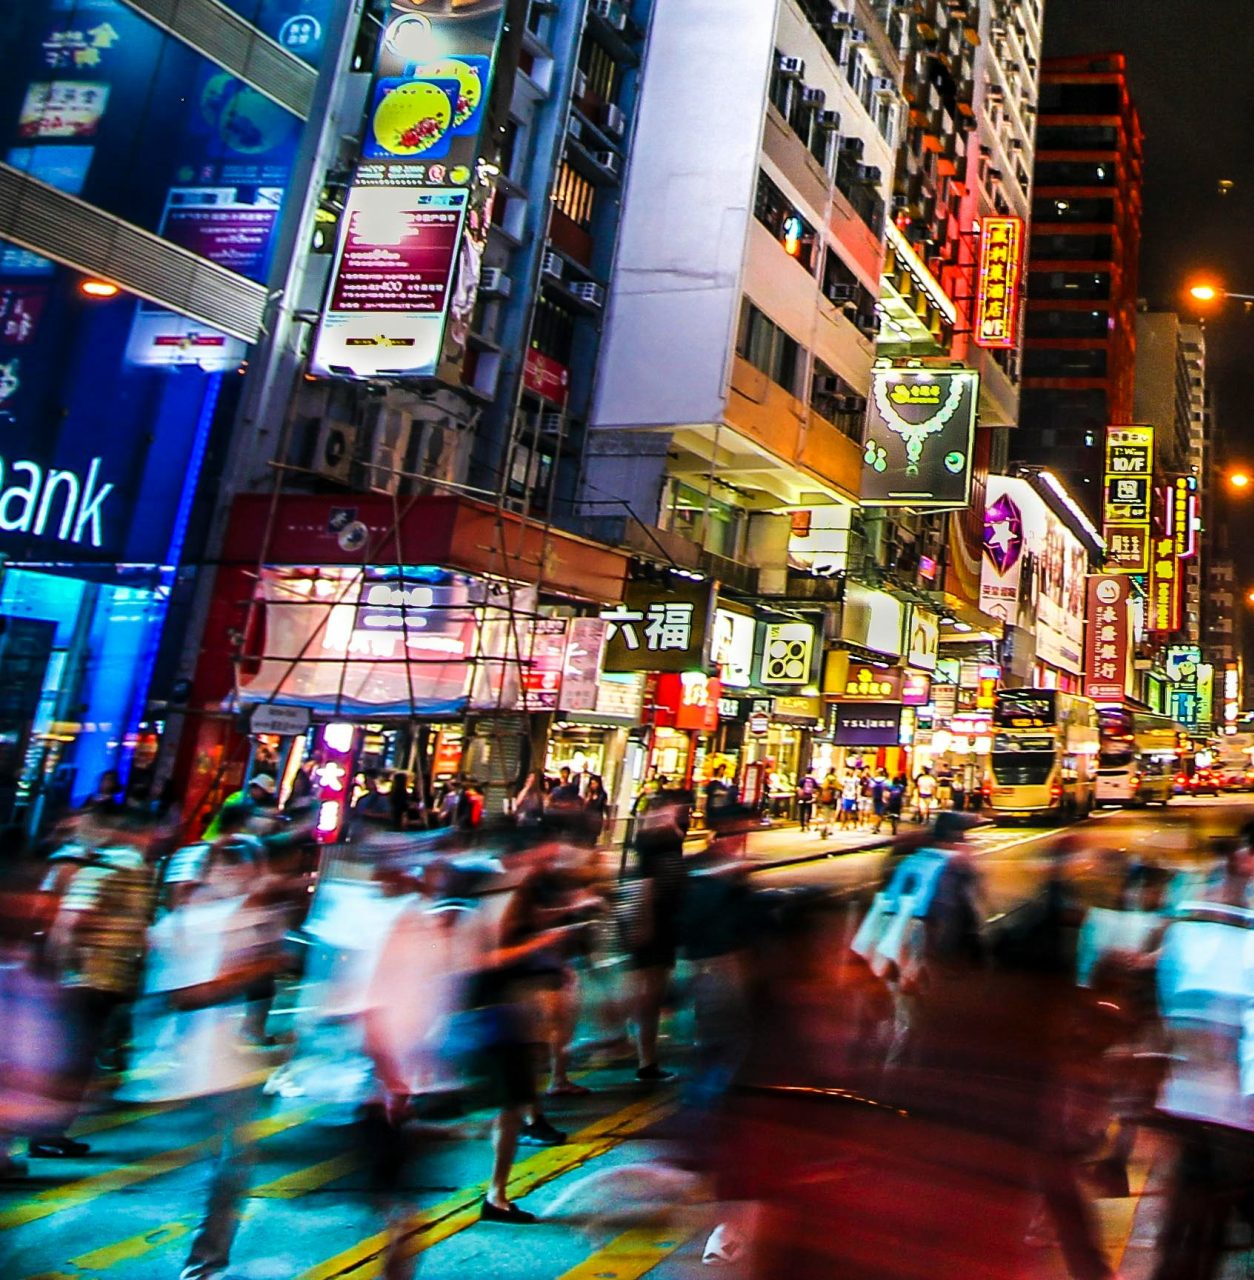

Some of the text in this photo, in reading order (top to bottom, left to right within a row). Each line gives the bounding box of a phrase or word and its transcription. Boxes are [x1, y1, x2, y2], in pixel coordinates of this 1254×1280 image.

[1113, 457, 1145, 471] 10/F
[0, 456, 115, 547] ank
[599, 602, 695, 651] 六福
